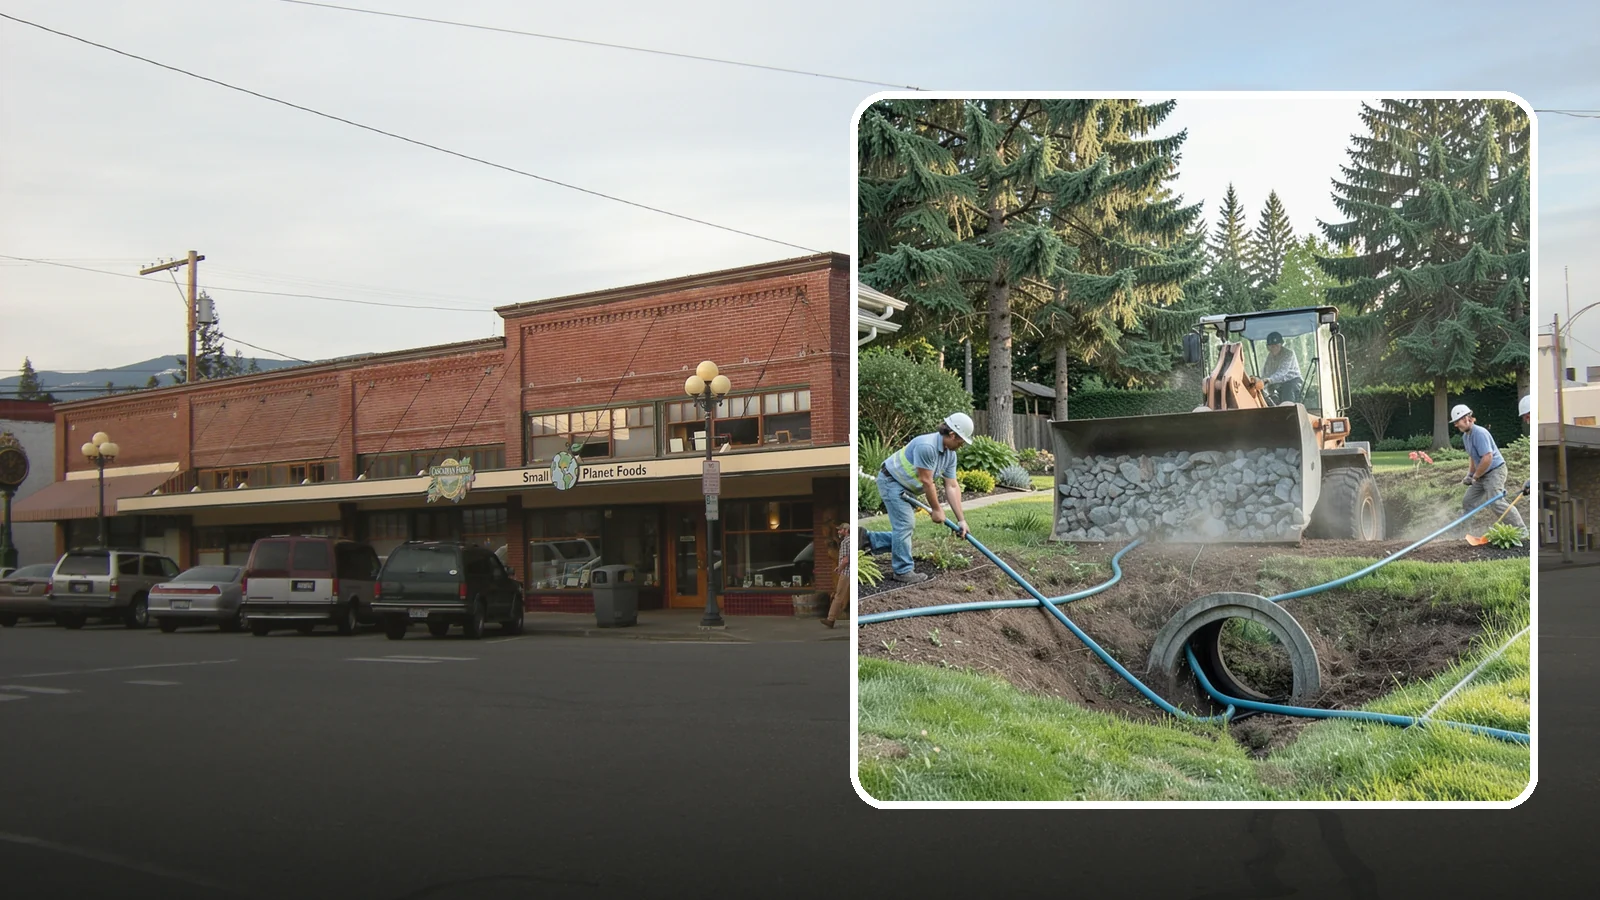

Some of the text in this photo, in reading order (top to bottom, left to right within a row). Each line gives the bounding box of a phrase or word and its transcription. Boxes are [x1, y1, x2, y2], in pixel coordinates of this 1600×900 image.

[523, 464, 647, 483] Small Planet Foods
